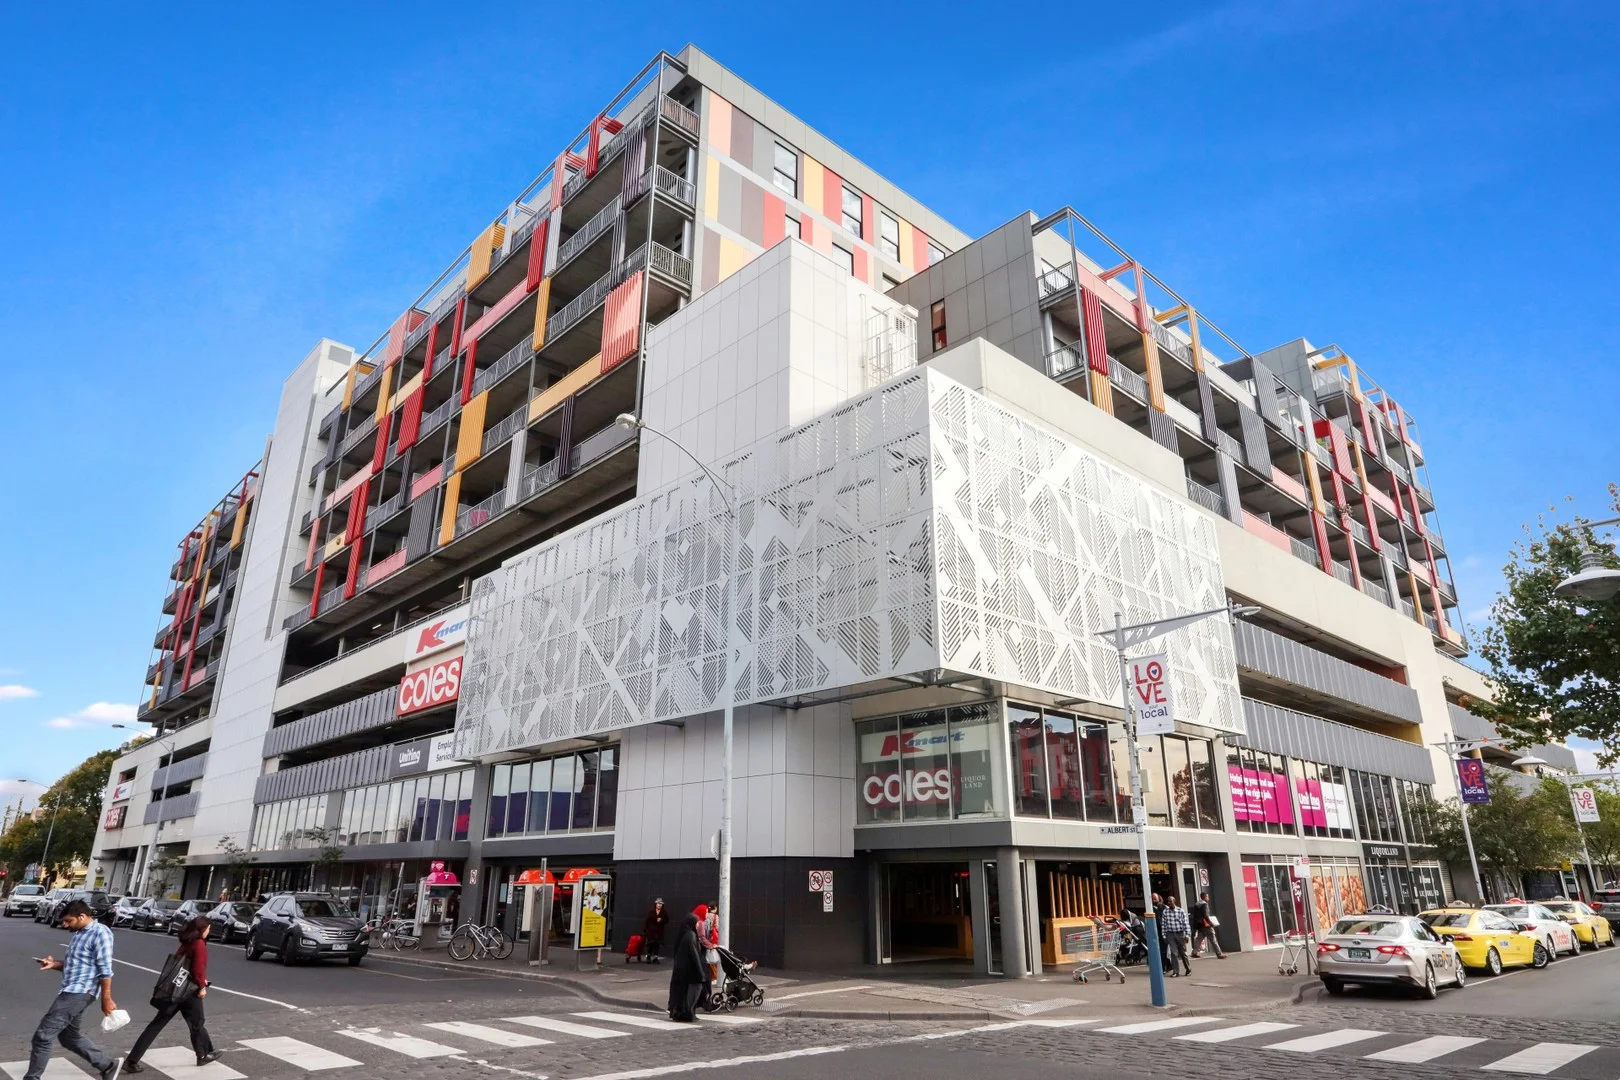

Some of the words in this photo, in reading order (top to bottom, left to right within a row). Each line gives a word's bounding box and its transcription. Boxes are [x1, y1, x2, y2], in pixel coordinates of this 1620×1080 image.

[400, 661, 459, 711] coles
[1140, 706, 1168, 719] local
[880, 730, 965, 756] Kmart
[863, 769, 954, 805] coles
[960, 775, 986, 783] LIQUOR
